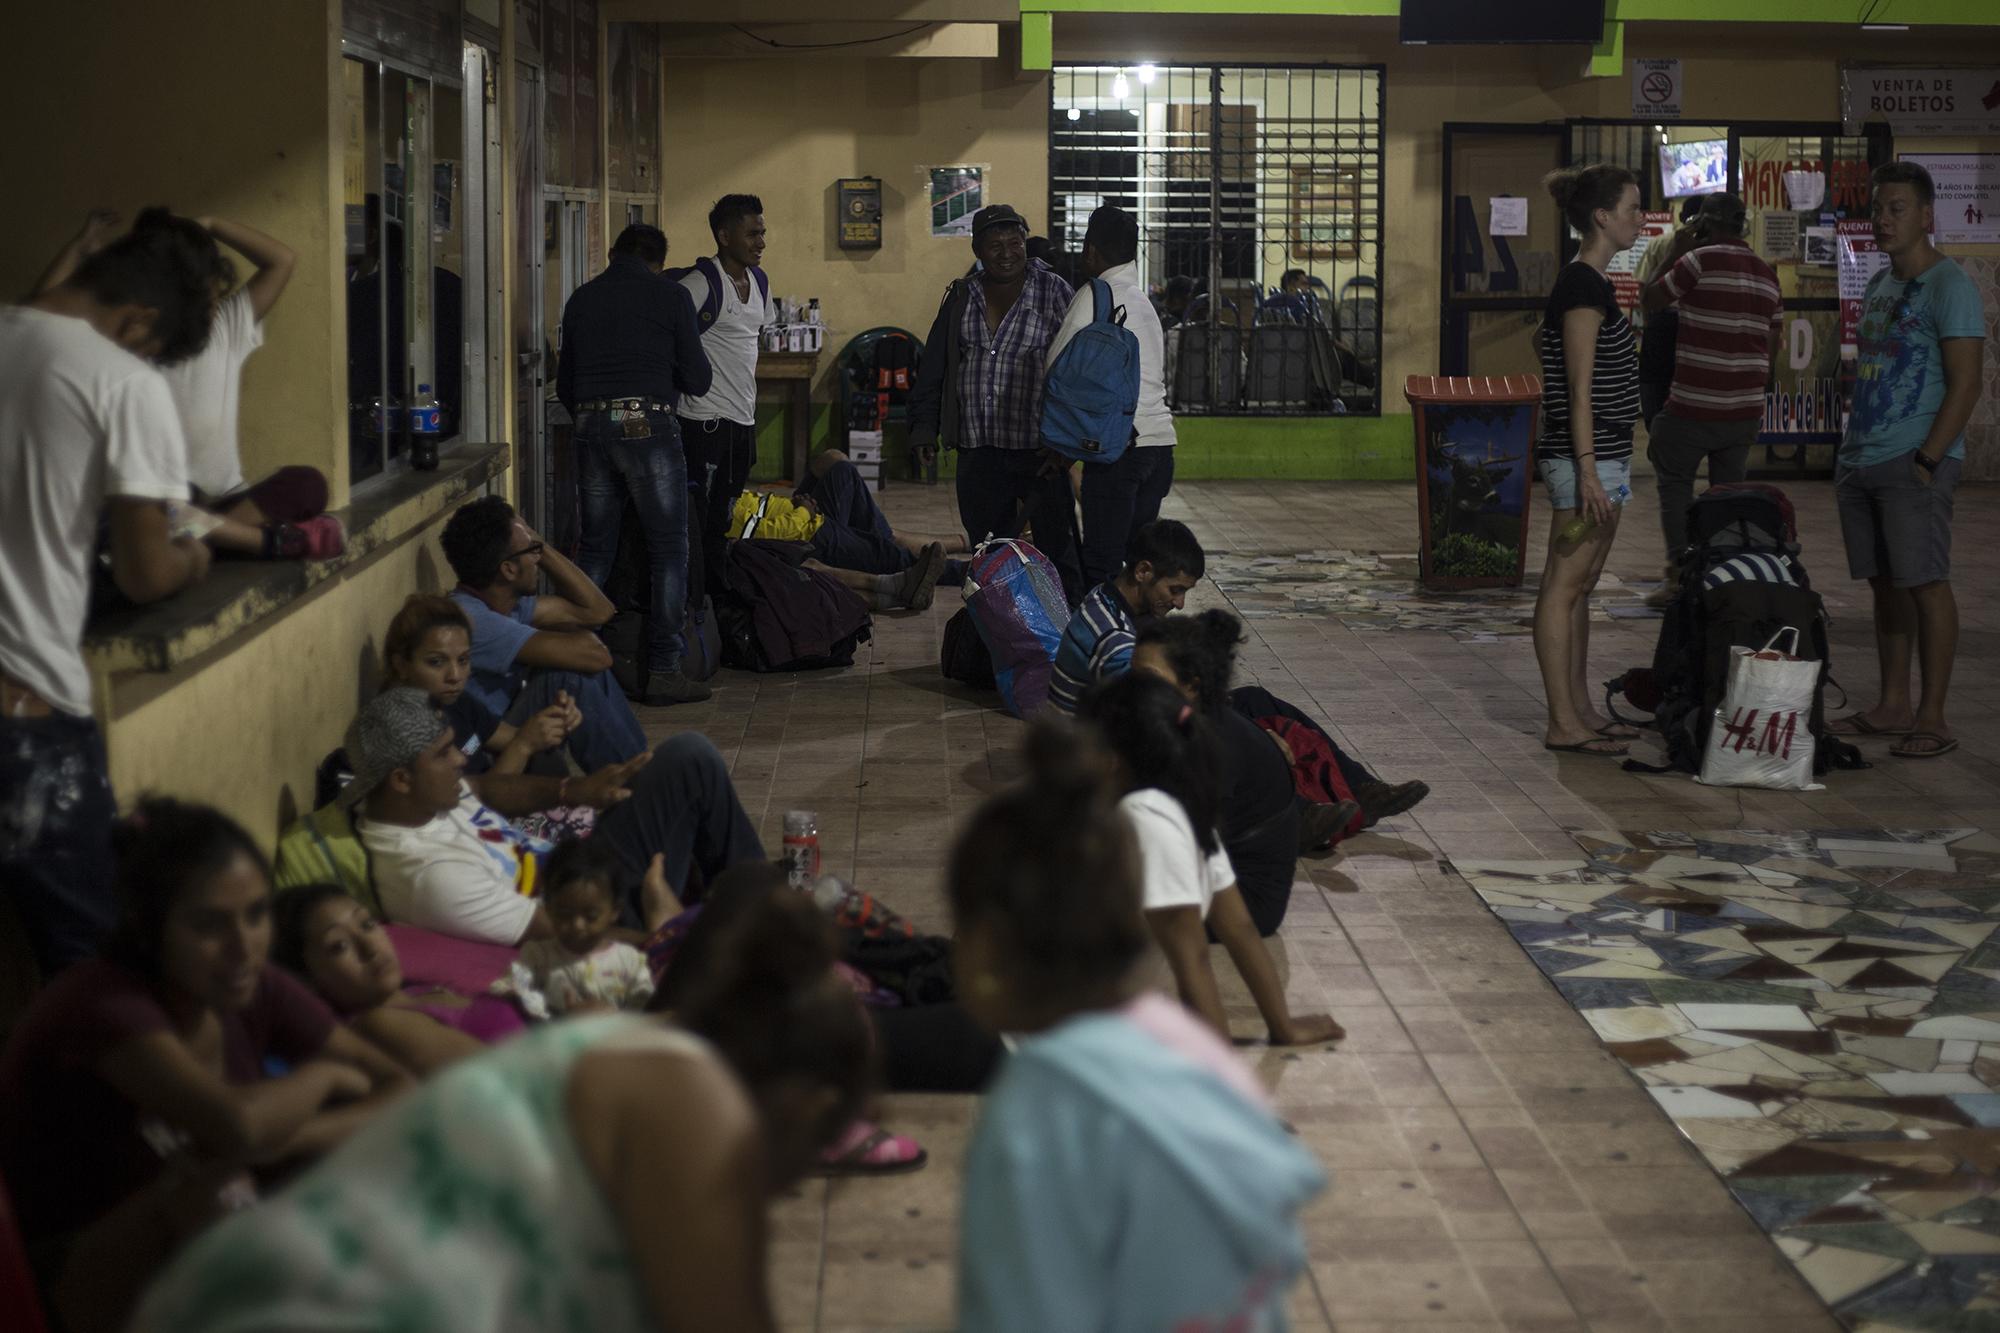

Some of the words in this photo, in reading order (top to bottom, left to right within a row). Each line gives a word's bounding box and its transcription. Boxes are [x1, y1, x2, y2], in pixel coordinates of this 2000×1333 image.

[1872, 80, 1926, 91] VENTA
[1934, 80, 1953, 91] DE
[1871, 96, 1954, 112] BOLETOS
[1944, 183, 1963, 191] AÑOS
[1838, 222, 1873, 232] FUENT
[1796, 377, 1820, 432] del
[1721, 706, 1796, 761] H&M
